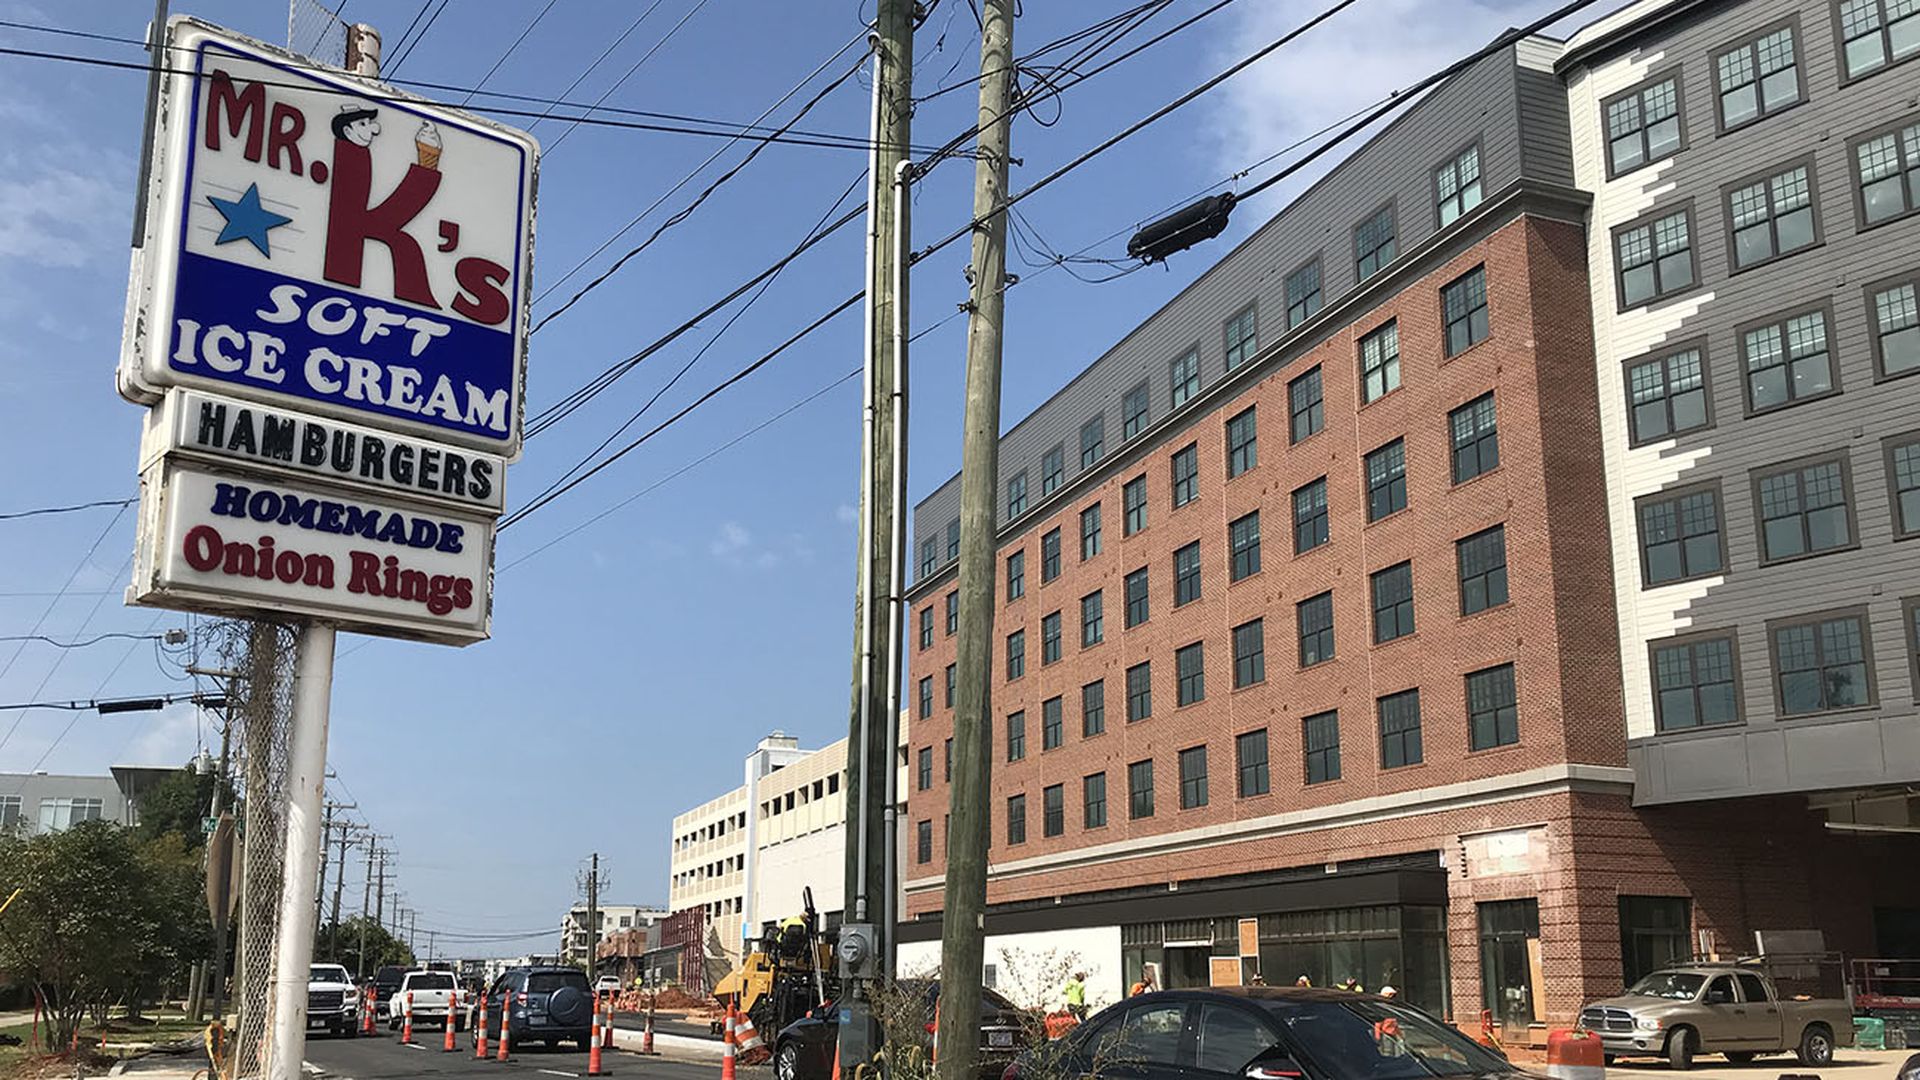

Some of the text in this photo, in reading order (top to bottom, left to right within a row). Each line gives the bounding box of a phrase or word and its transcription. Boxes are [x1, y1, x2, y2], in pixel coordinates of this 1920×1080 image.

[206, 70, 510, 325] MR. K's
[256, 284, 451, 357] SOFT
[173, 319, 509, 432] ICE CREAM
[197, 401, 493, 499] HAMBURGERS
[211, 483, 464, 553] HOMEMADE
[183, 525, 473, 616] Onion Rings
